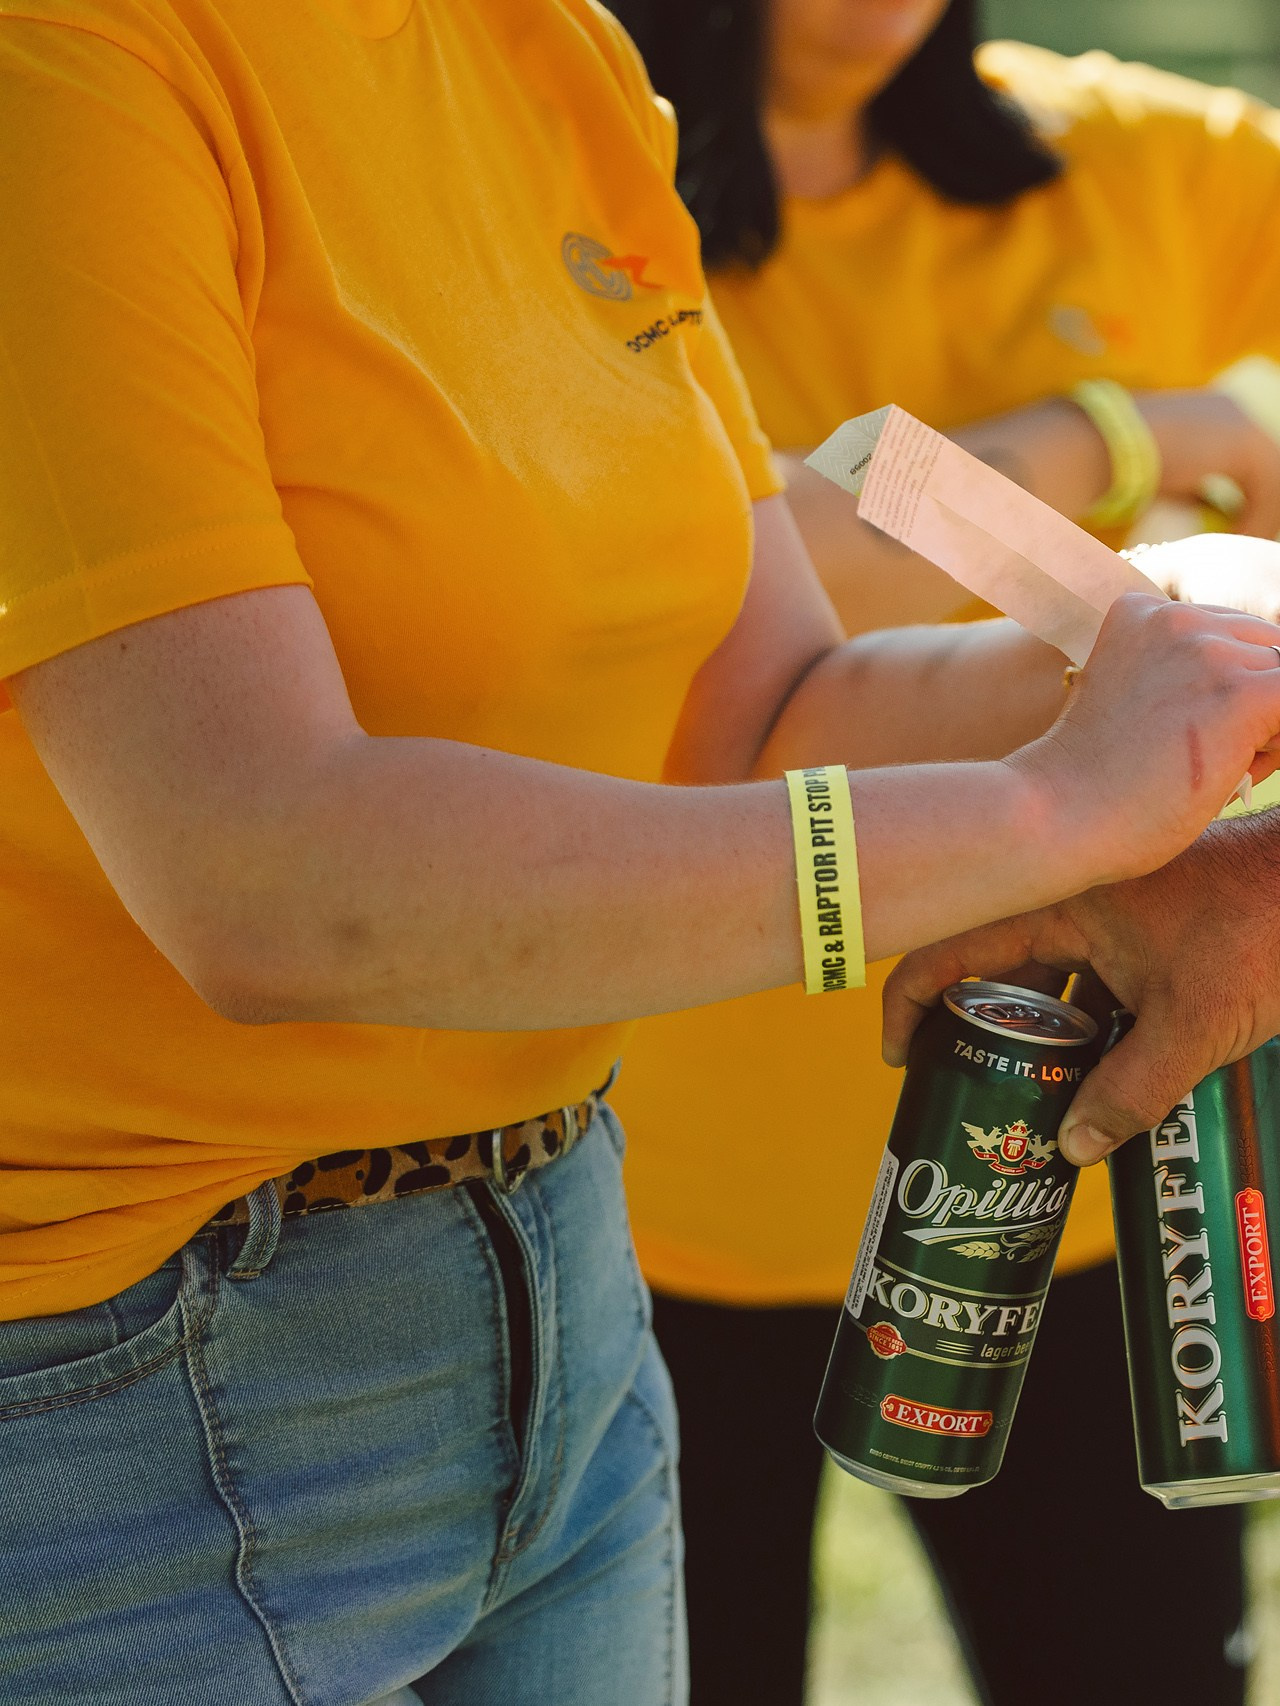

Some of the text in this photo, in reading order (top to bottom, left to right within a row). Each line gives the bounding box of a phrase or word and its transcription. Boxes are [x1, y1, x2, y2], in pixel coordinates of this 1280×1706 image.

[805, 779, 832, 812] STOP
[810, 817, 835, 848] PIT
[814, 852, 843, 936] RAPTOR
[824, 939, 845, 952] &
[953, 1040, 1009, 1073] TASTE
[1014, 1061, 1036, 1080] IT.
[897, 1158, 1069, 1227] Opillia
[1150, 1089, 1228, 1448] KORYFE
[1243, 1206, 1268, 1303] EXPORT
[980, 1343, 1014, 1360] lager
[896, 1403, 983, 1433] EXPORT
